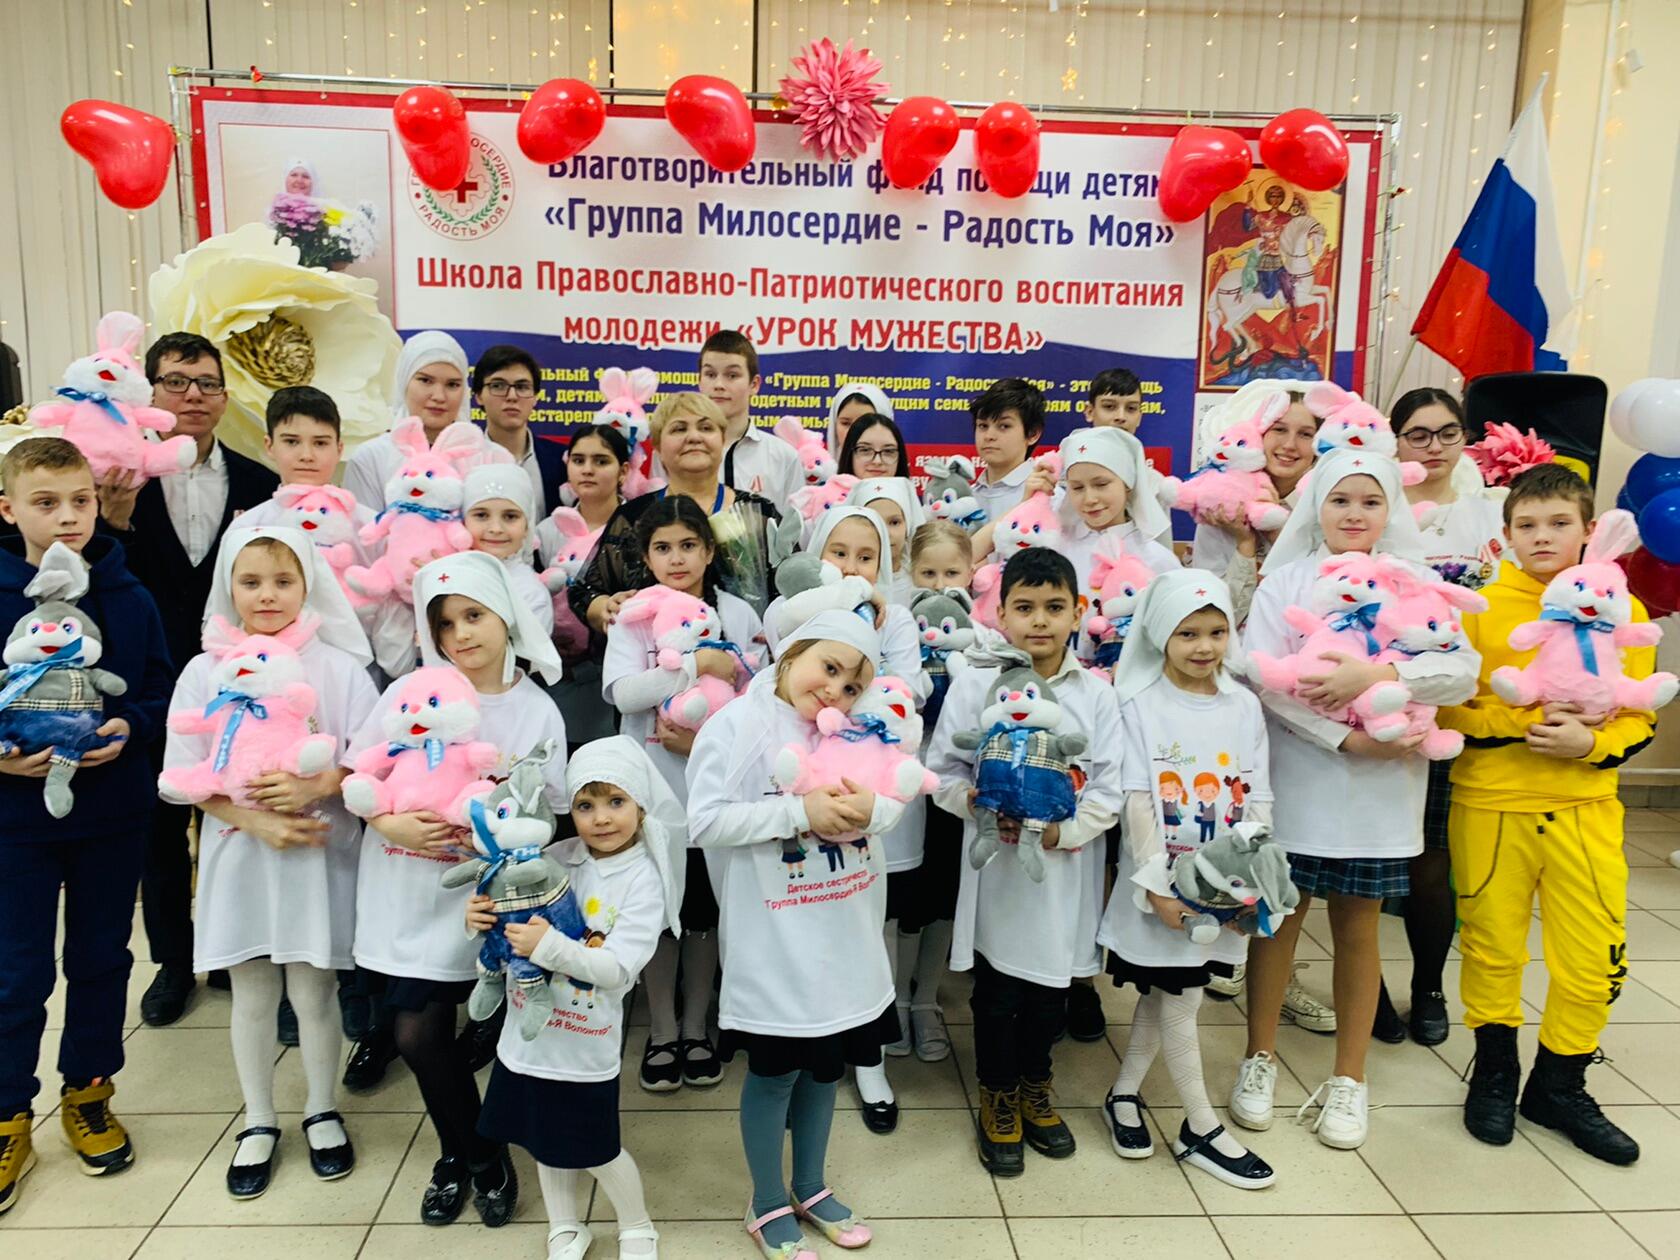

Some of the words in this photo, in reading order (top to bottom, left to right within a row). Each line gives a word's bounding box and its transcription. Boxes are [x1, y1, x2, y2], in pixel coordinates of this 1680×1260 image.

[470, 137, 512, 189] ОСЕРДИЕ
[867, 159, 944, 195] фд
[956, 168, 1071, 198] пощи
[418, 204, 478, 237] РАДОСТЬ
[480, 206, 505, 231] МОЯ
[545, 197, 683, 239] «Группа
[698, 202, 901, 245] Милосердие
[943, 209, 1074, 248] Радость
[1088, 214, 1175, 247] Моя»
[417, 257, 522, 290] Школа
[536, 260, 1004, 304] Православно-Патриотического
[1016, 280, 1184, 307] воспитания
[850, 318, 1044, 351] МУЖЕСТВА»
[764, 372, 829, 391] «Группа
[945, 376, 999, 393] Радос
[750, 394, 822, 410] одетным
[934, 398, 971, 412] семь
